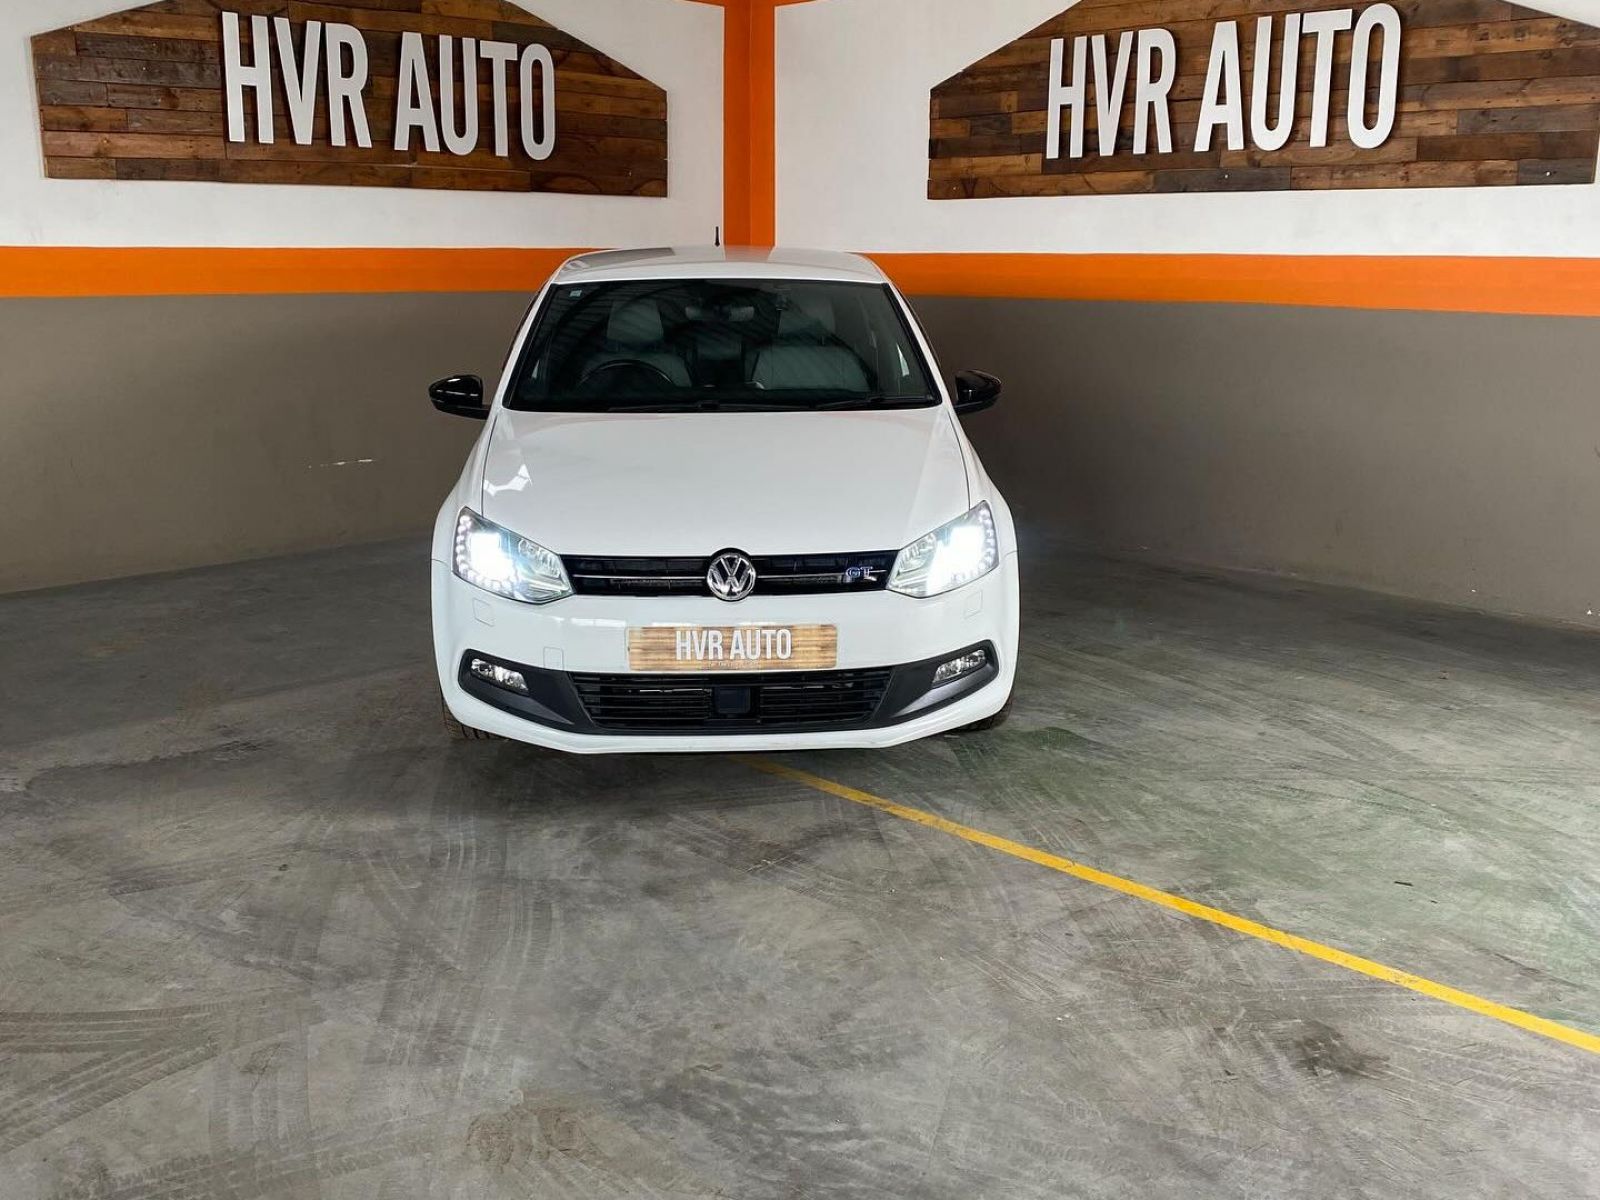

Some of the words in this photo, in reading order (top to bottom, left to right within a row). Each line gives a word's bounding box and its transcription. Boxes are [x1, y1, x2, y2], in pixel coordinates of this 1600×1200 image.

[221, 11, 372, 148] HVR
[394, 31, 556, 161] AUTO
[1046, 28, 1177, 159] HVR
[1193, 3, 1402, 152] AUTO
[675, 629, 723, 661] HVR
[729, 628, 792, 660] AUTO
